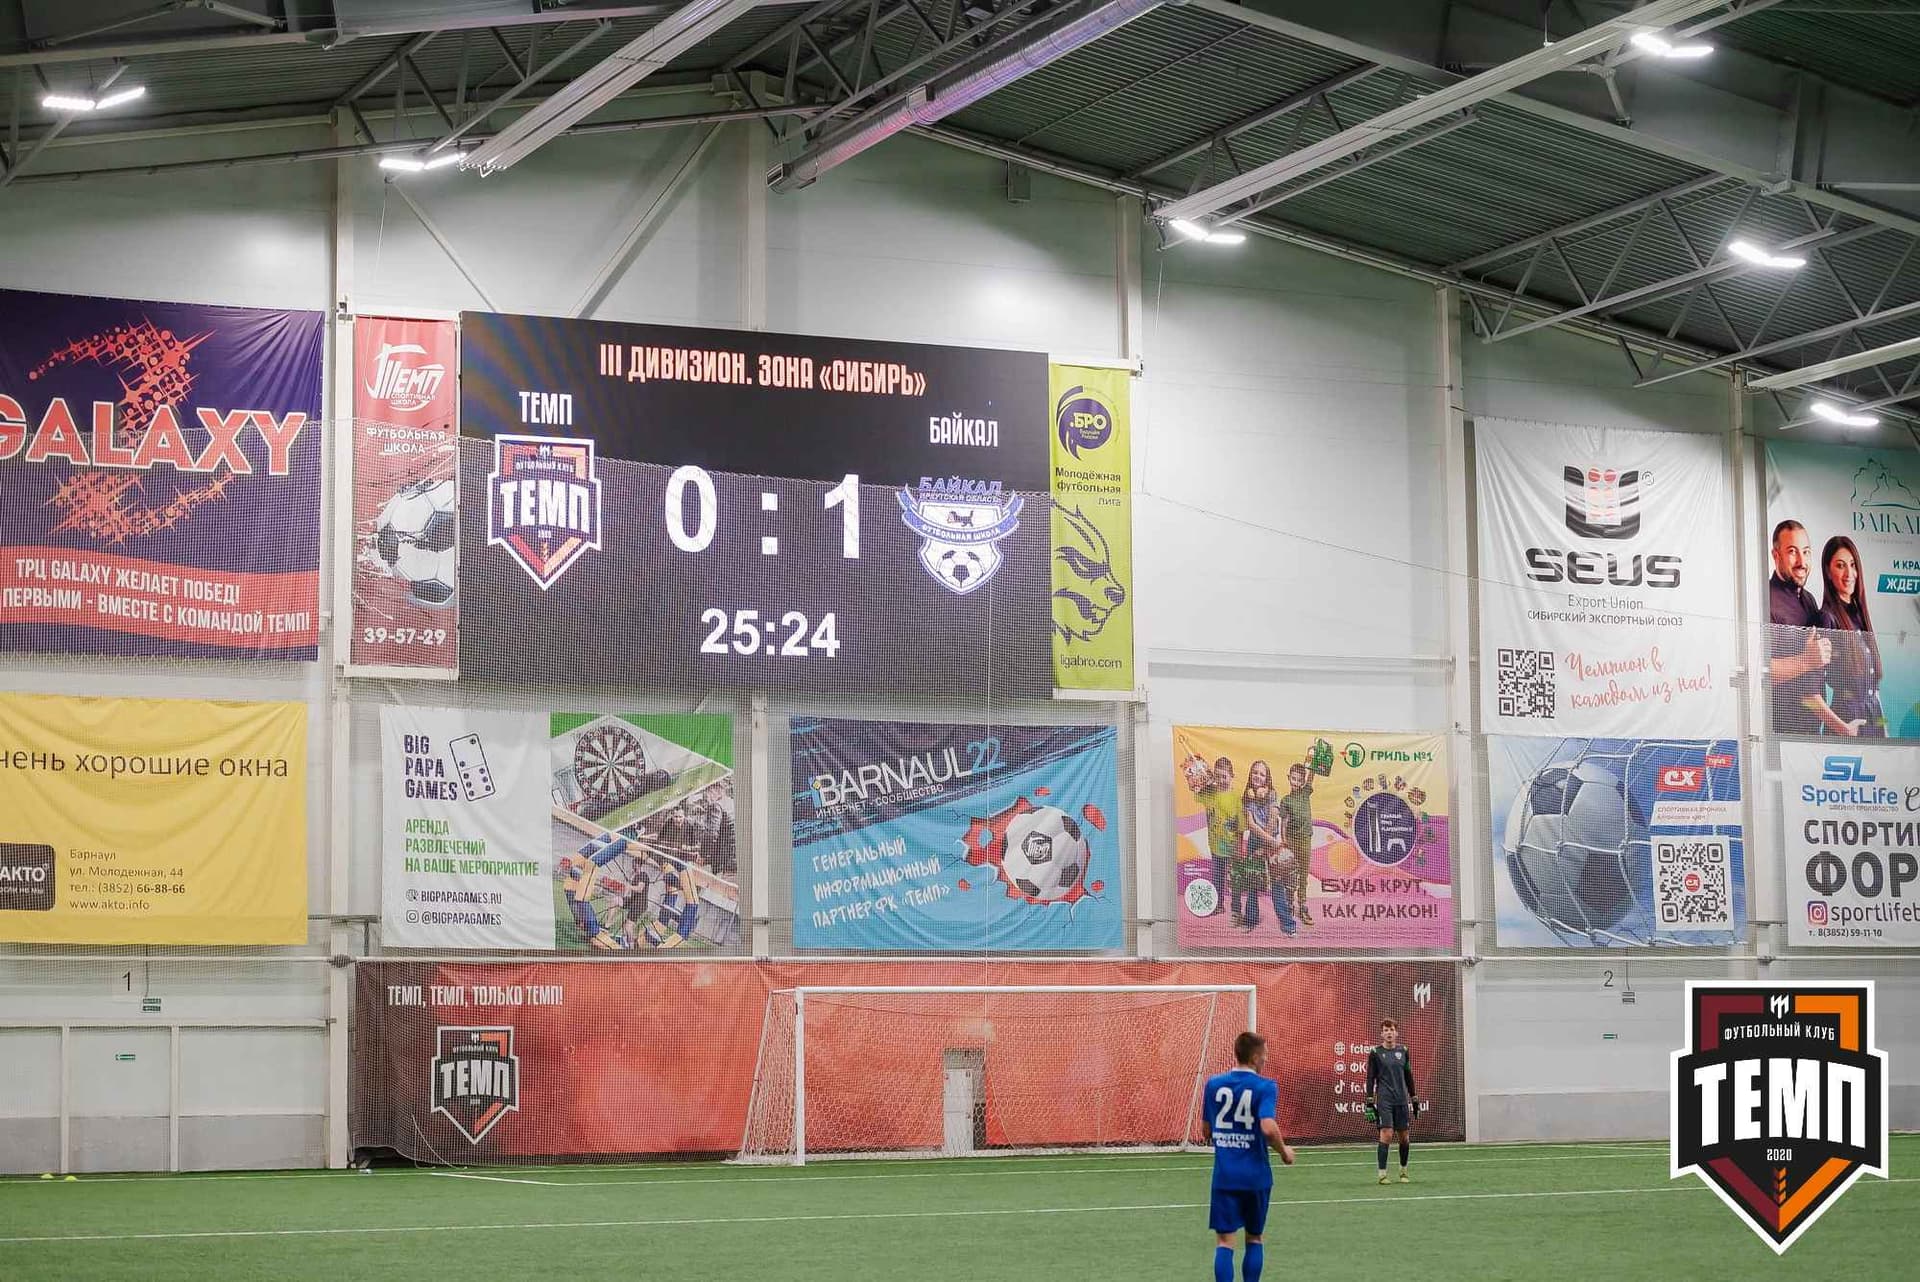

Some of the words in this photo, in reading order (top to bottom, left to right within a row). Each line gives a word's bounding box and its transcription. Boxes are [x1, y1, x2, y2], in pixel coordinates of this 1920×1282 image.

[628, 346, 752, 384] ДИВИЗИОН.
[758, 354, 813, 389] ЗОНА
[819, 360, 927, 397] «СИБИРЬ»
[519, 391, 573, 425] ТЕМП
[0, 394, 307, 476] GALAXY
[366, 427, 446, 441] ФУТБОЛЬНАЯ
[929, 411, 999, 448] БАЙКАЛ
[384, 443, 425, 454] ШКОЛА
[1055, 467, 1121, 482] Молодёжная
[919, 475, 1002, 496] БАЙКАЛ
[1057, 481, 1121, 494] футбольная
[500, 479, 590, 534] ТЕМП
[665, 465, 717, 553] 0
[824, 473, 860, 559] 1
[1525, 548, 1682, 588] SEUS
[1893, 560, 1900, 568] И
[16, 558, 46, 579] ТРЦ
[51, 560, 110, 585] GALAXY
[115, 568, 179, 596] ЖЕЛАЕТ
[184, 579, 240, 605] ПОБЕД!
[3, 587, 82, 610] ПЕРВЫМИ
[98, 593, 159, 622] ВМЕСТЕ
[164, 604, 172, 623] С
[177, 607, 263, 634] КОМАНДОЙ
[1567, 593, 1606, 610] Export
[1610, 596, 1644, 610] Union
[1527, 609, 1586, 623] СИБИРСКИЙ
[1589, 613, 1655, 626] ЭКСПОРТНЫЙ
[364, 628, 447, 645] 39-57-29
[700, 607, 840, 658] 25:24
[404, 735, 430, 754] BIG
[75, 753, 210, 779] хорошие
[219, 757, 288, 777] окна
[1370, 750, 1410, 761] ГРИЛЬ
[1413, 752, 1433, 761] №1
[405, 757, 444, 778] PAPA
[1822, 755, 1876, 782] SL
[405, 779, 458, 801] GAMES
[816, 800, 866, 818] ИНТЕРНЕТ
[876, 783, 944, 807] СООБЩЕСТВО
[1802, 784, 1898, 806] SportLife
[405, 819, 450, 835] АРЕНДА
[1804, 820, 1920, 847] СПОРТИ
[70, 848, 117, 861] Барнаул
[405, 838, 486, 856] РАЗВЛЕЧЕНИЙ
[812, 835, 907, 872] ГЕНЕРАЛЬНЫЙ
[0, 866, 45, 882] АКТО
[70, 866, 85, 877] ул.
[88, 866, 167, 879] Молодежная,
[170, 868, 184, 878] 44
[405, 858, 421, 873] НА
[424, 859, 457, 875] ВАШЕ
[460, 861, 540, 877] МЕРОПРИЯТИЕ
[1805, 851, 1919, 898] ФОР
[98, 883, 133, 895] (3852)
[136, 883, 186, 894] 66-88-66
[812, 855, 941, 902] ИНФОРМАЦИОННЫЙ
[1321, 878, 1376, 893] БУДЬ
[1380, 879, 1428, 896] КРУТ,
[69, 899, 150, 910] www.akto.info
[421, 890, 502, 905] BIGPAPAGAMES.RU
[421, 911, 502, 926] @BIGPAPAGAMES
[812, 900, 873, 929] ПАРТНЕР
[875, 895, 898, 914] ФК
[1322, 904, 1358, 918] КАК
[1362, 904, 1439, 921] ДРАКОН!
[1818, 928, 1849, 938] 8(3852)
[1850, 929, 1882, 937] 59-11-10
[123, 971, 131, 992] 1
[1603, 970, 1614, 987] 2
[388, 986, 426, 1008] ТЕМП,
[431, 986, 468, 1008] ТЕМП,
[472, 985, 522, 1006] ТОЛЬКО
[526, 985, 563, 1006] ТЕМП!
[440, 1059, 509, 1099] ТЕМП
[1215, 1087, 1254, 1130] 24
